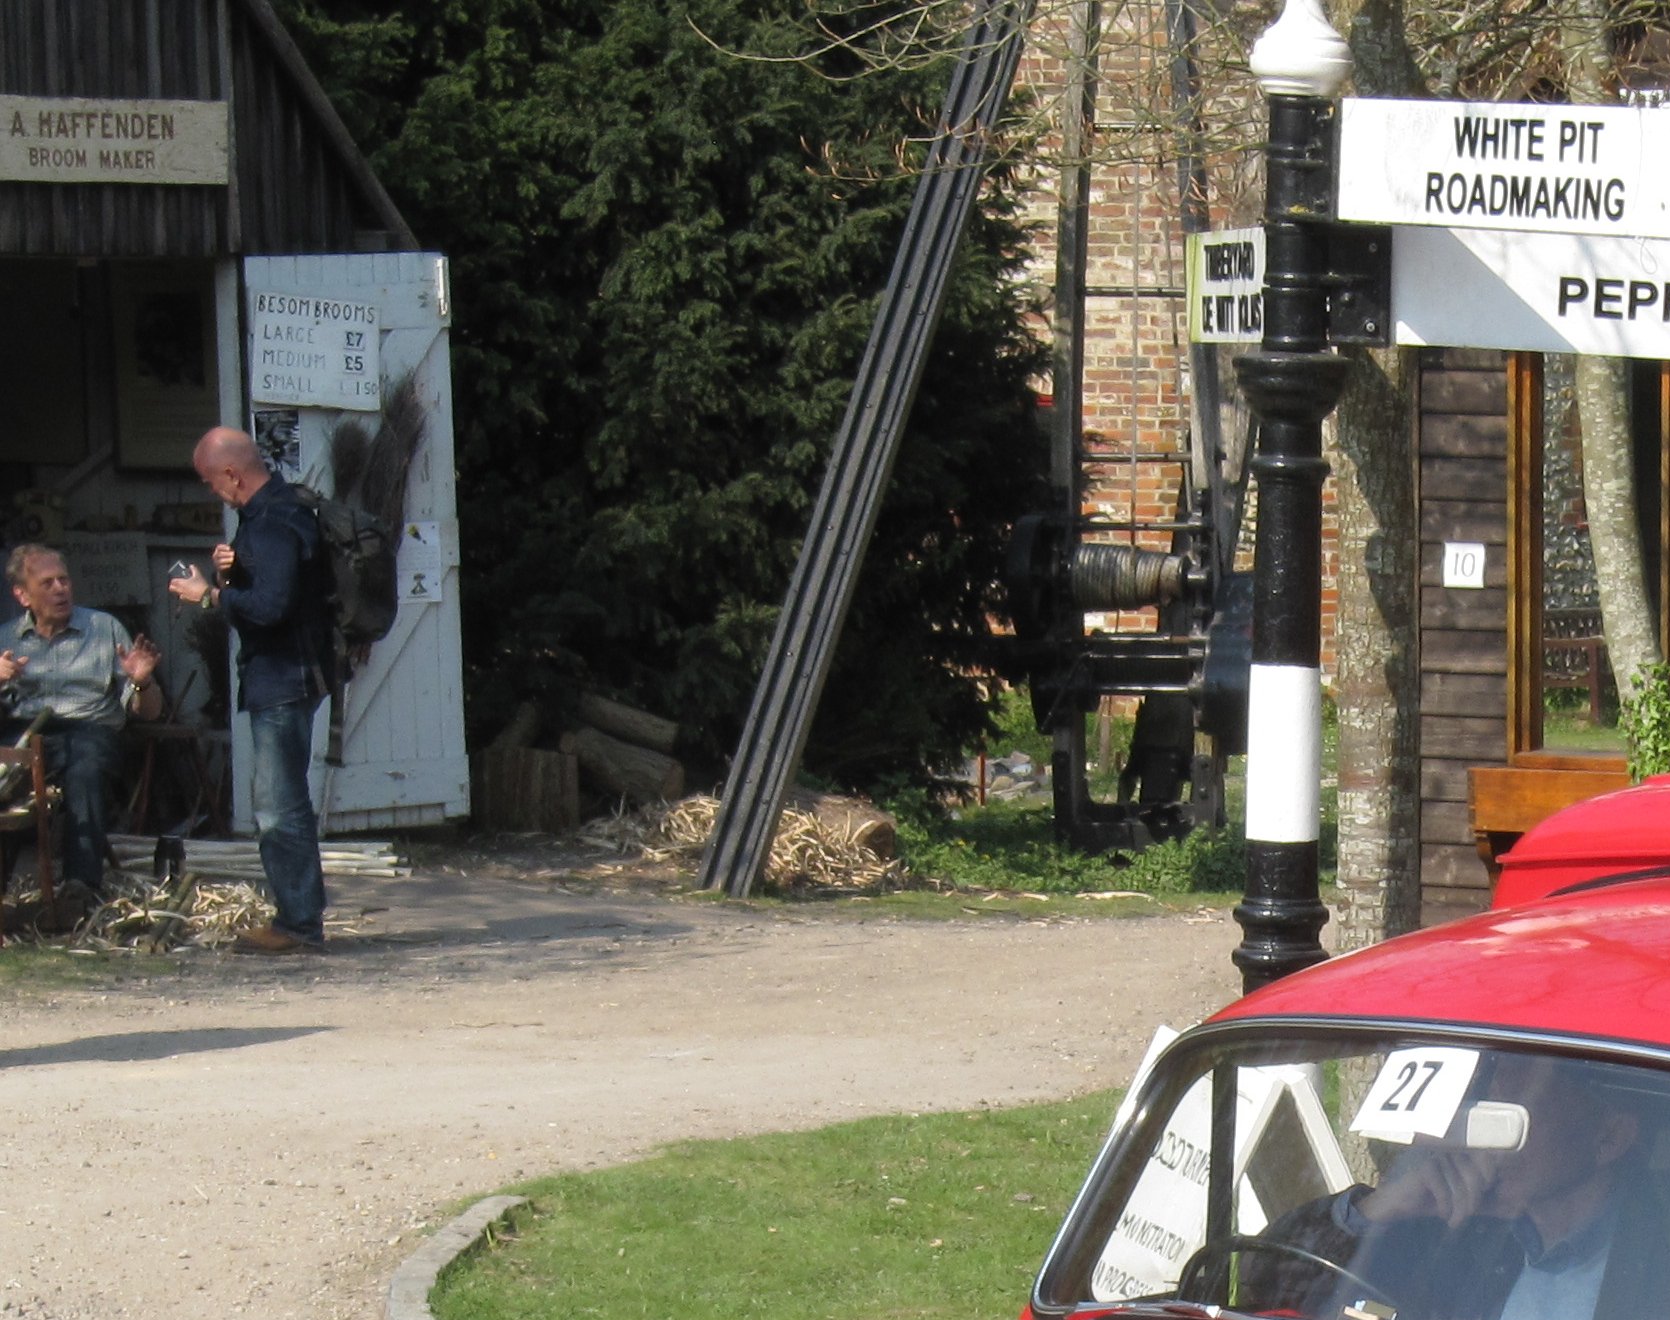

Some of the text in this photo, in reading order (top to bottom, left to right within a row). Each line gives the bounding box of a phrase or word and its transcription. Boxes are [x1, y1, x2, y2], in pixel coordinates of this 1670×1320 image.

[38, 110, 175, 140] HAFFENDEN
[1453, 116, 1605, 164] WHITE PIT
[28, 147, 156, 170] BROOM MAKER
[1424, 171, 1626, 222] ROADMAKING
[257, 294, 376, 324] BESOM BROOMS
[263, 323, 364, 348] LARGE £7
[262, 349, 364, 372] MEDIUM £5
[262, 374, 314, 393] SMALL
[1454, 552, 1476, 577] 10
[1379, 1060, 1445, 1112] 27
